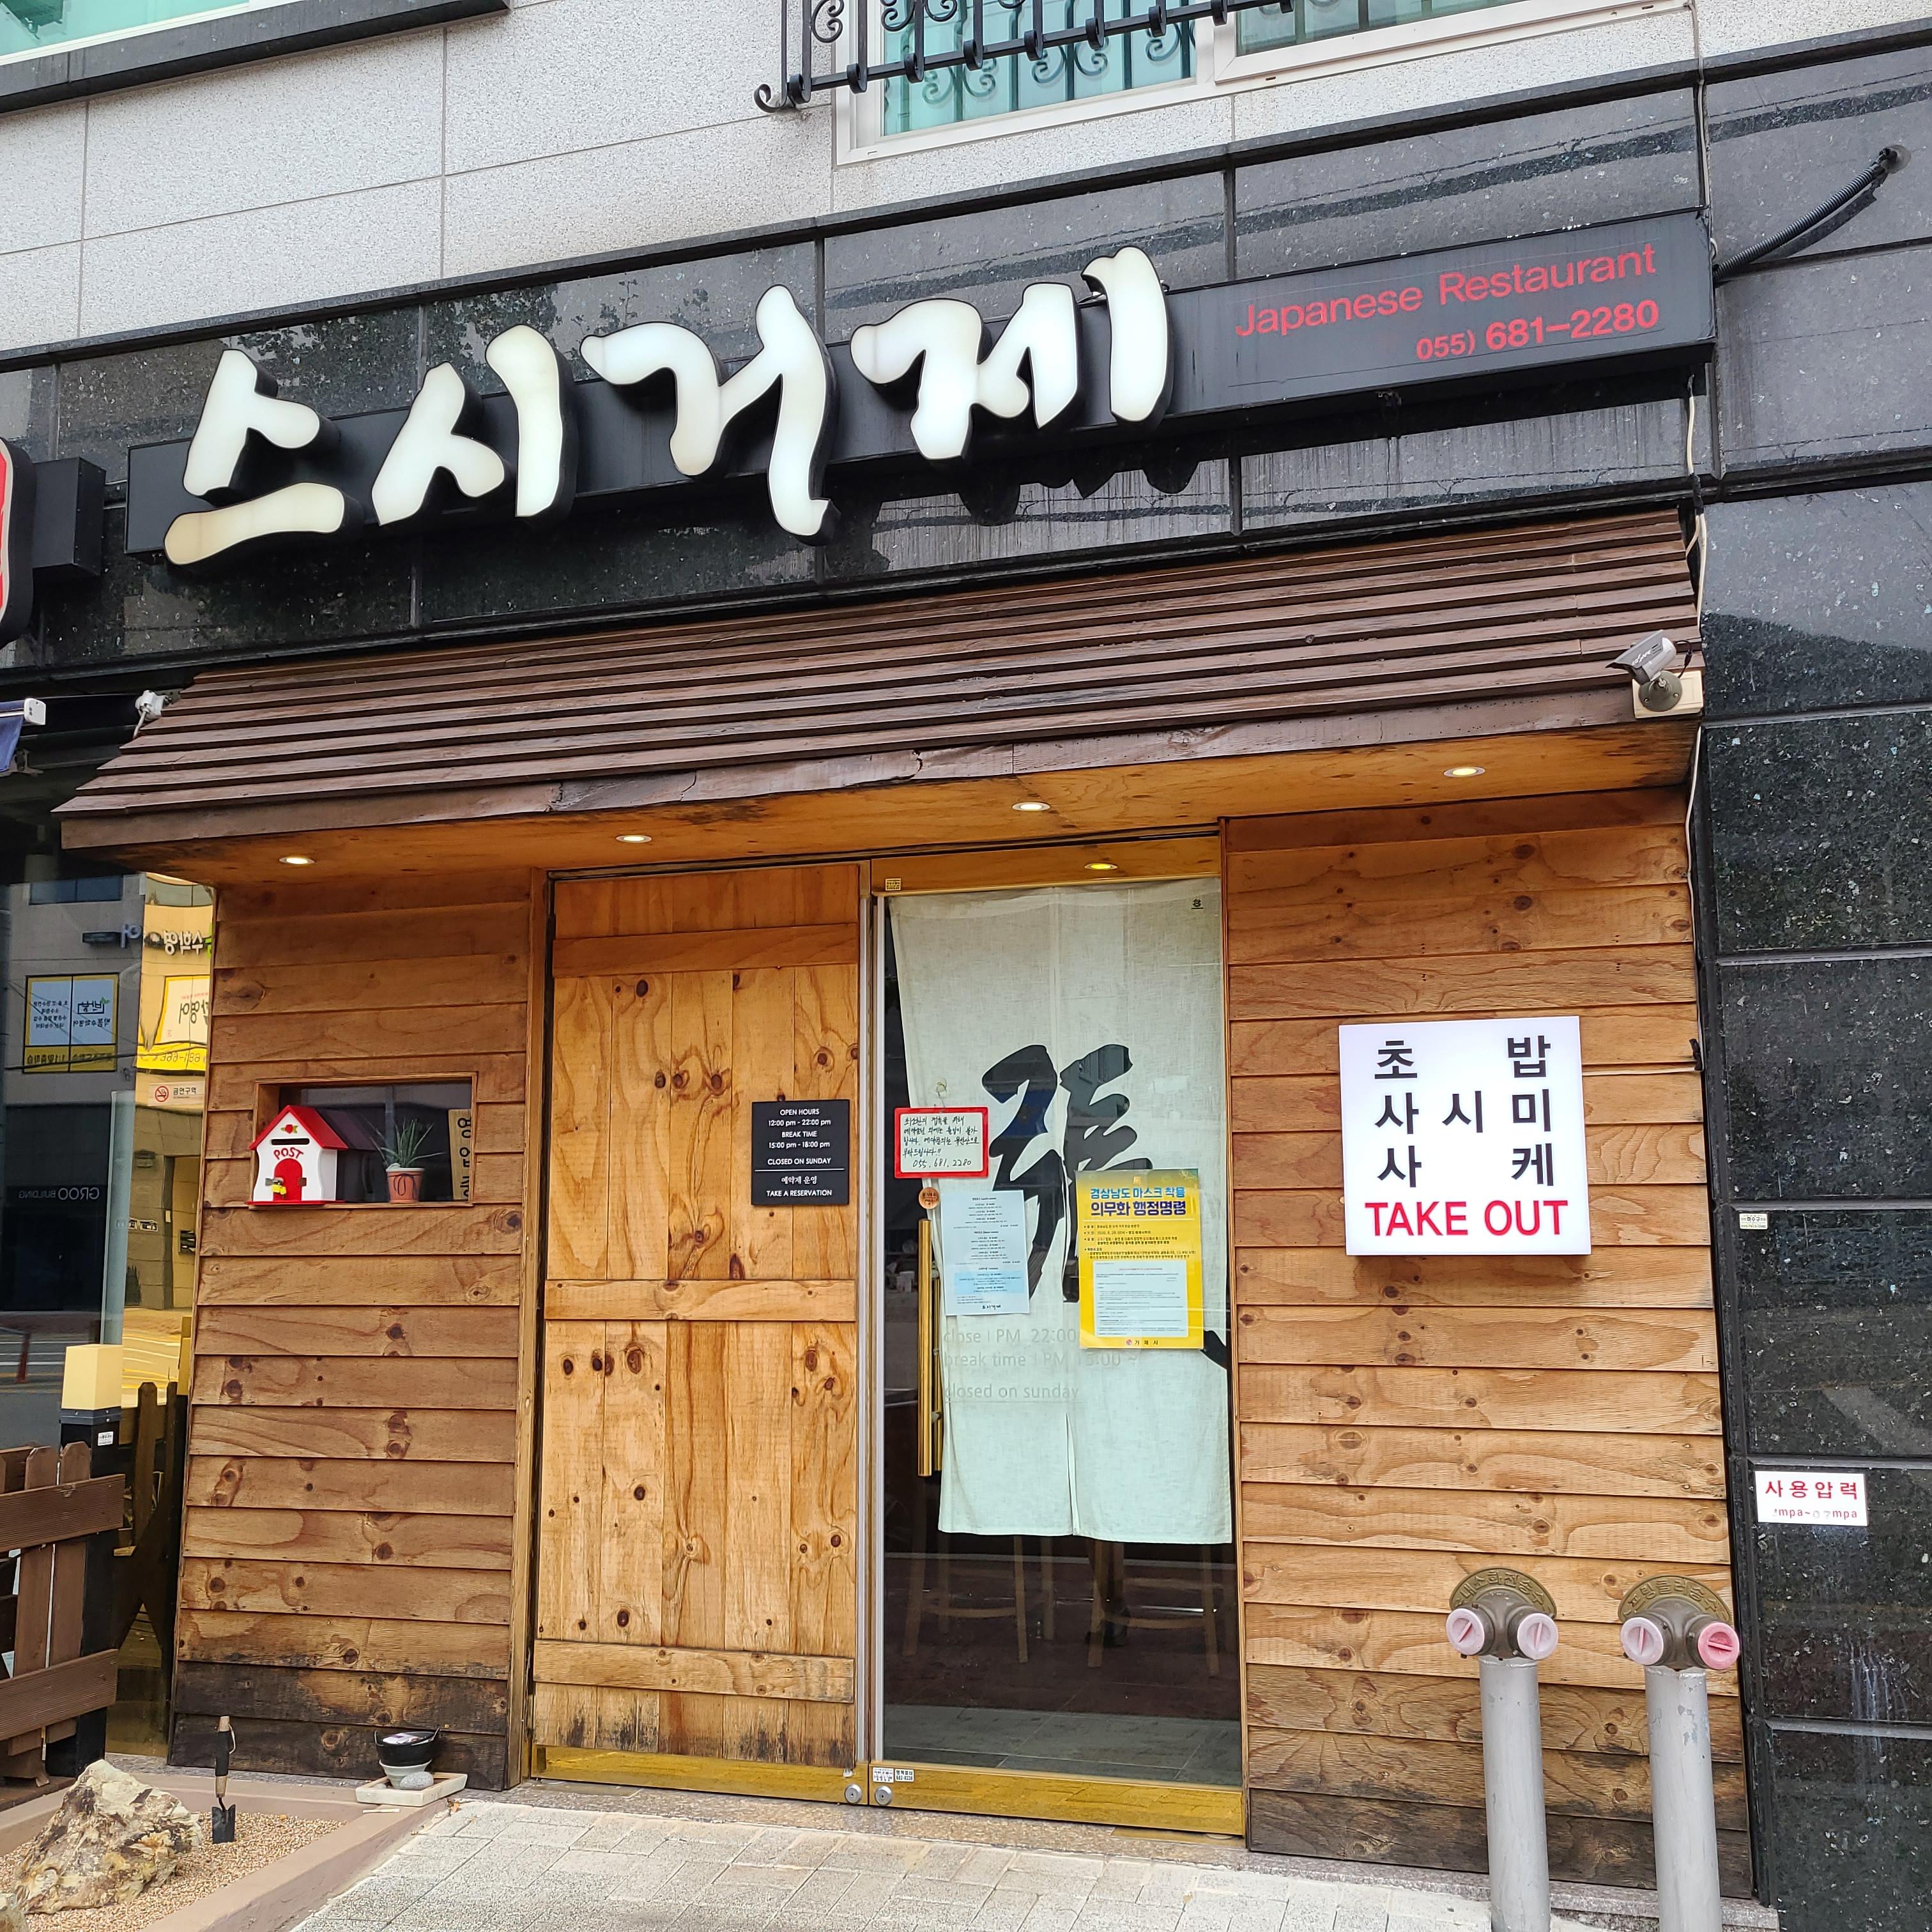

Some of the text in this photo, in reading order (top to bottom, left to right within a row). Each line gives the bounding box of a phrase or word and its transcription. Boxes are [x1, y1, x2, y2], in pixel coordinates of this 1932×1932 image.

[1235, 243, 1657, 338] Japanese Restaurant
[1416, 300, 1659, 361] 055) 681-2280
[164, 247, 1169, 565] 스시거제
[173, 1087, 196, 1095] 금연구역
[965, 1126, 978, 1135] 불가
[273, 1147, 304, 1160] POST
[952, 1158, 972, 1167] 2280
[803, 1176, 817, 1184] 운영
[1090, 1186, 1186, 1200] 경상남도 마스크 착용
[1091, 1200, 1186, 1217] 의무화 행정명령
[1365, 1200, 1568, 1236] TAKE OUT
[944, 1329, 981, 1344] close
[996, 1328, 1021, 1344] PM
[1031, 1328, 1077, 1344] 22:00
[944, 1351, 986, 1367] break
[992, 1351, 1026, 1367] time
[1043, 1353, 1065, 1366] PM
[945, 1383, 1079, 1403] closed on sunday
[1765, 1480, 1858, 1500] 사용압력
